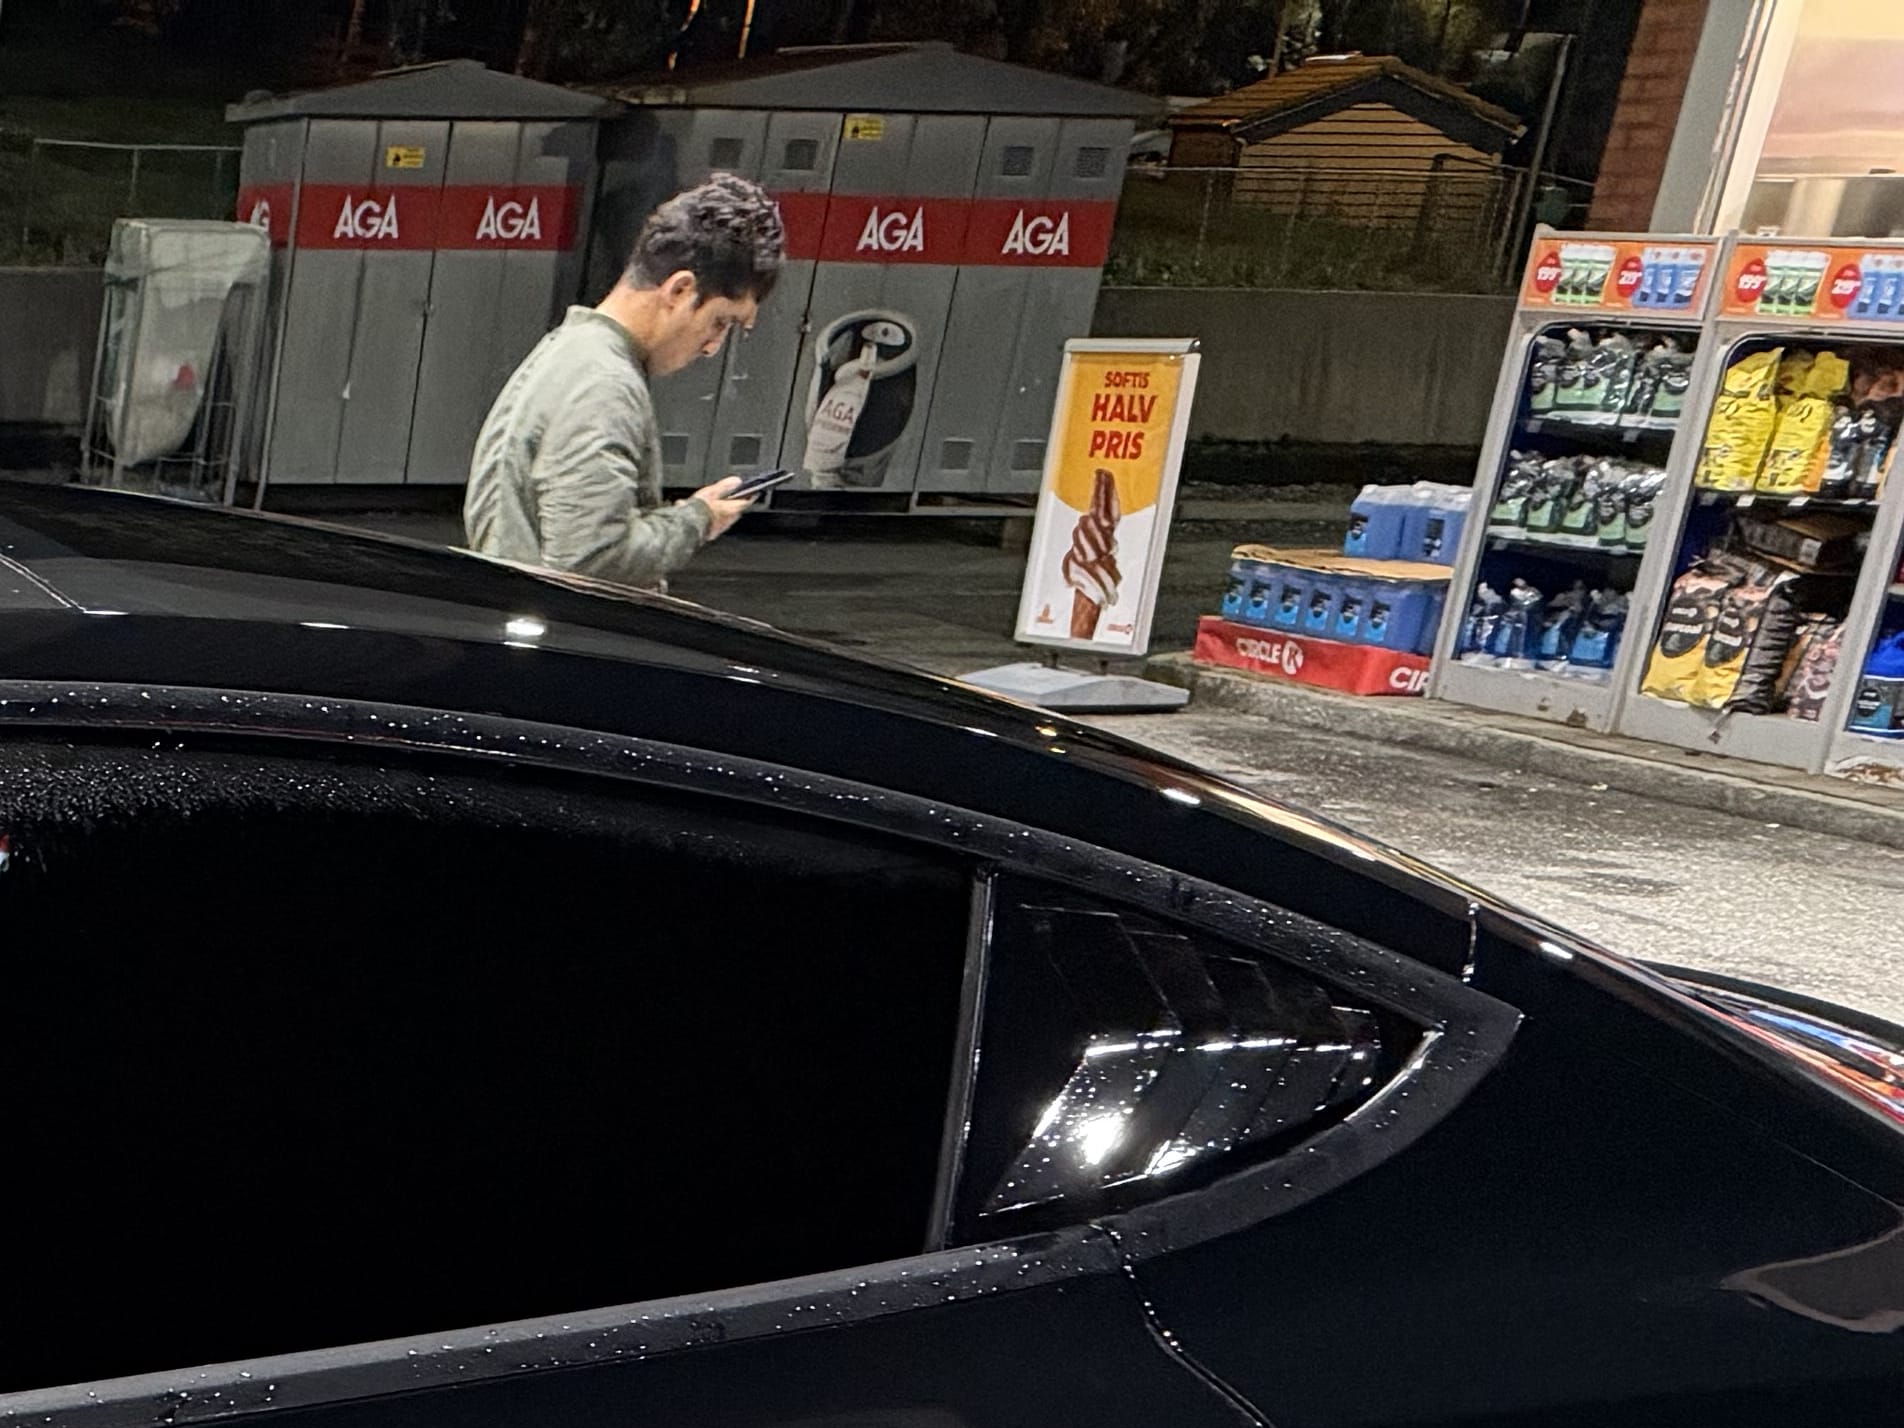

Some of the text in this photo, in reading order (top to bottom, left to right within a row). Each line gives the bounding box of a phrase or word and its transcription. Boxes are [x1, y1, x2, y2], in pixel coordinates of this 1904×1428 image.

[334, 194, 399, 239] AGA
[476, 196, 541, 240] AGA
[856, 206, 924, 252] AGA
[1001, 209, 1070, 256] AGA
[1104, 371, 1150, 389] SOFTIS
[1090, 394, 1158, 424] HALV
[1088, 430, 1145, 460] PRIS
[1236, 637, 1304, 675] CIRCLE K
